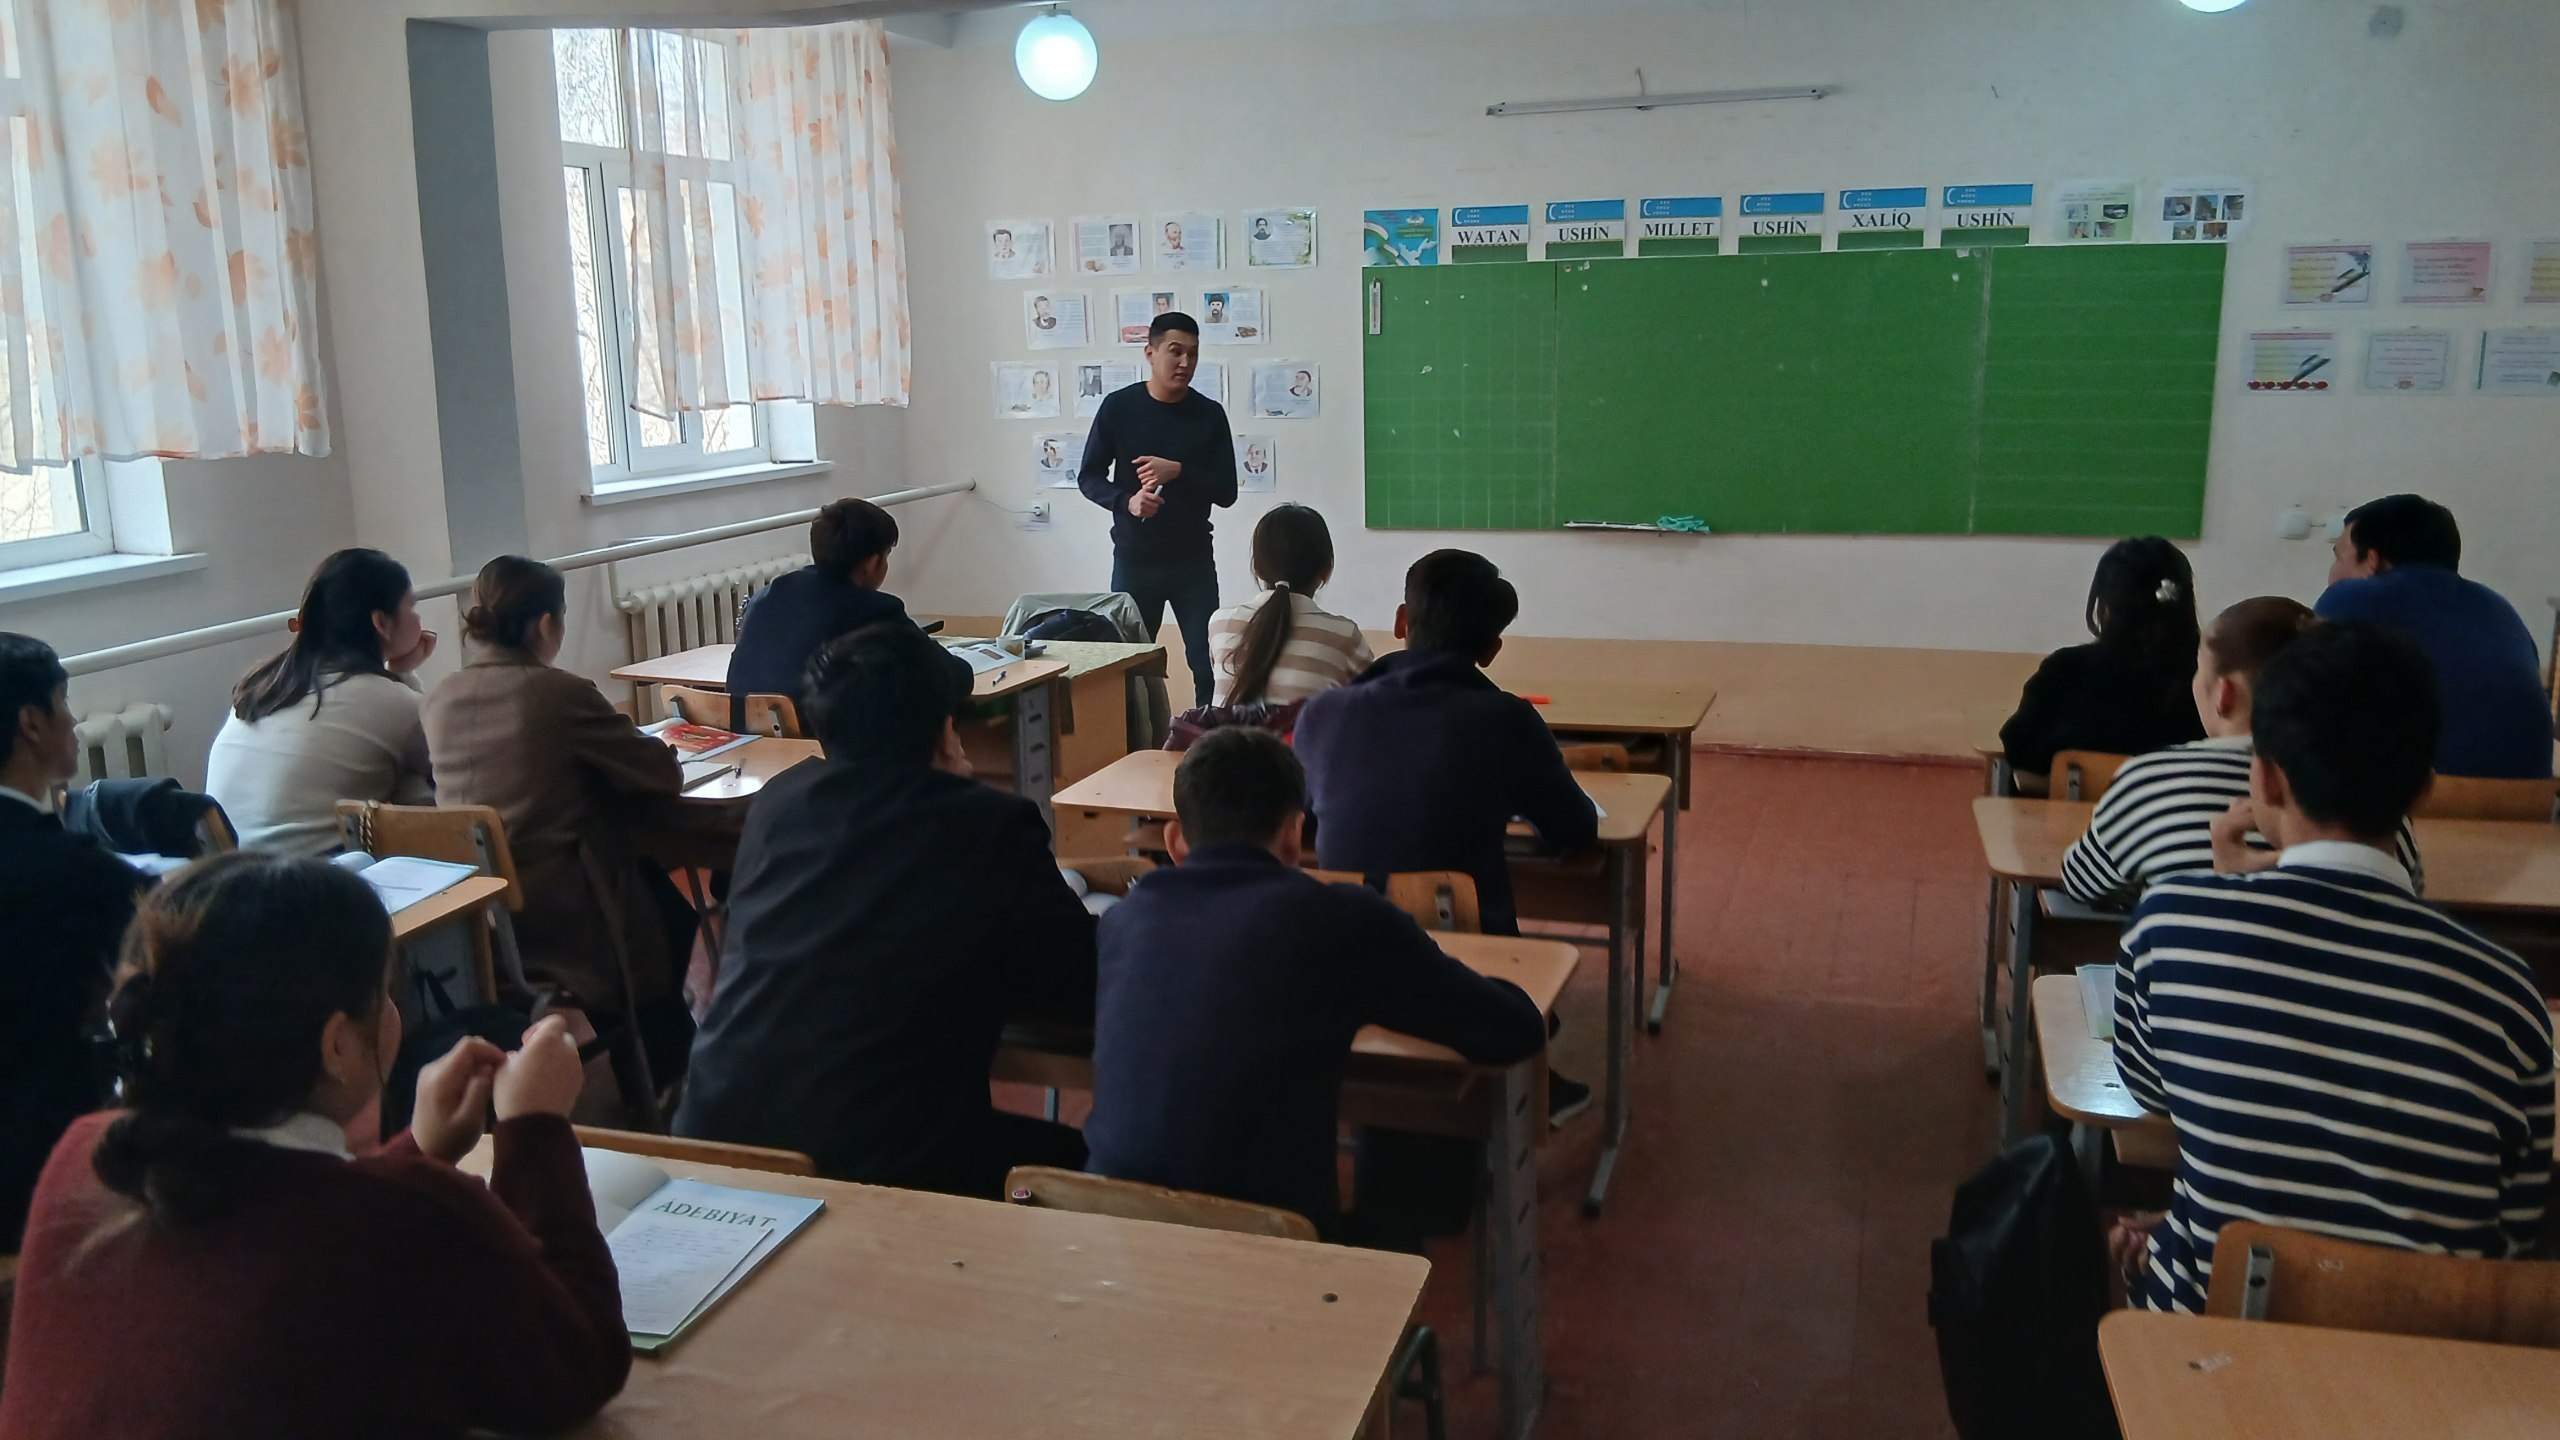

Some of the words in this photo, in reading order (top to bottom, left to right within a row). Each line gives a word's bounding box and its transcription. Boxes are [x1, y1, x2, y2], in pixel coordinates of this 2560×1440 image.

[1753, 216, 1808, 236] USHÍN
[1851, 208, 1911, 230] XALÍQ
[1957, 206, 2015, 228] USHÍN
[1457, 228, 1521, 245] WATAN
[1558, 221, 1610, 242] USHÍN
[1644, 220, 1715, 237] MILLET
